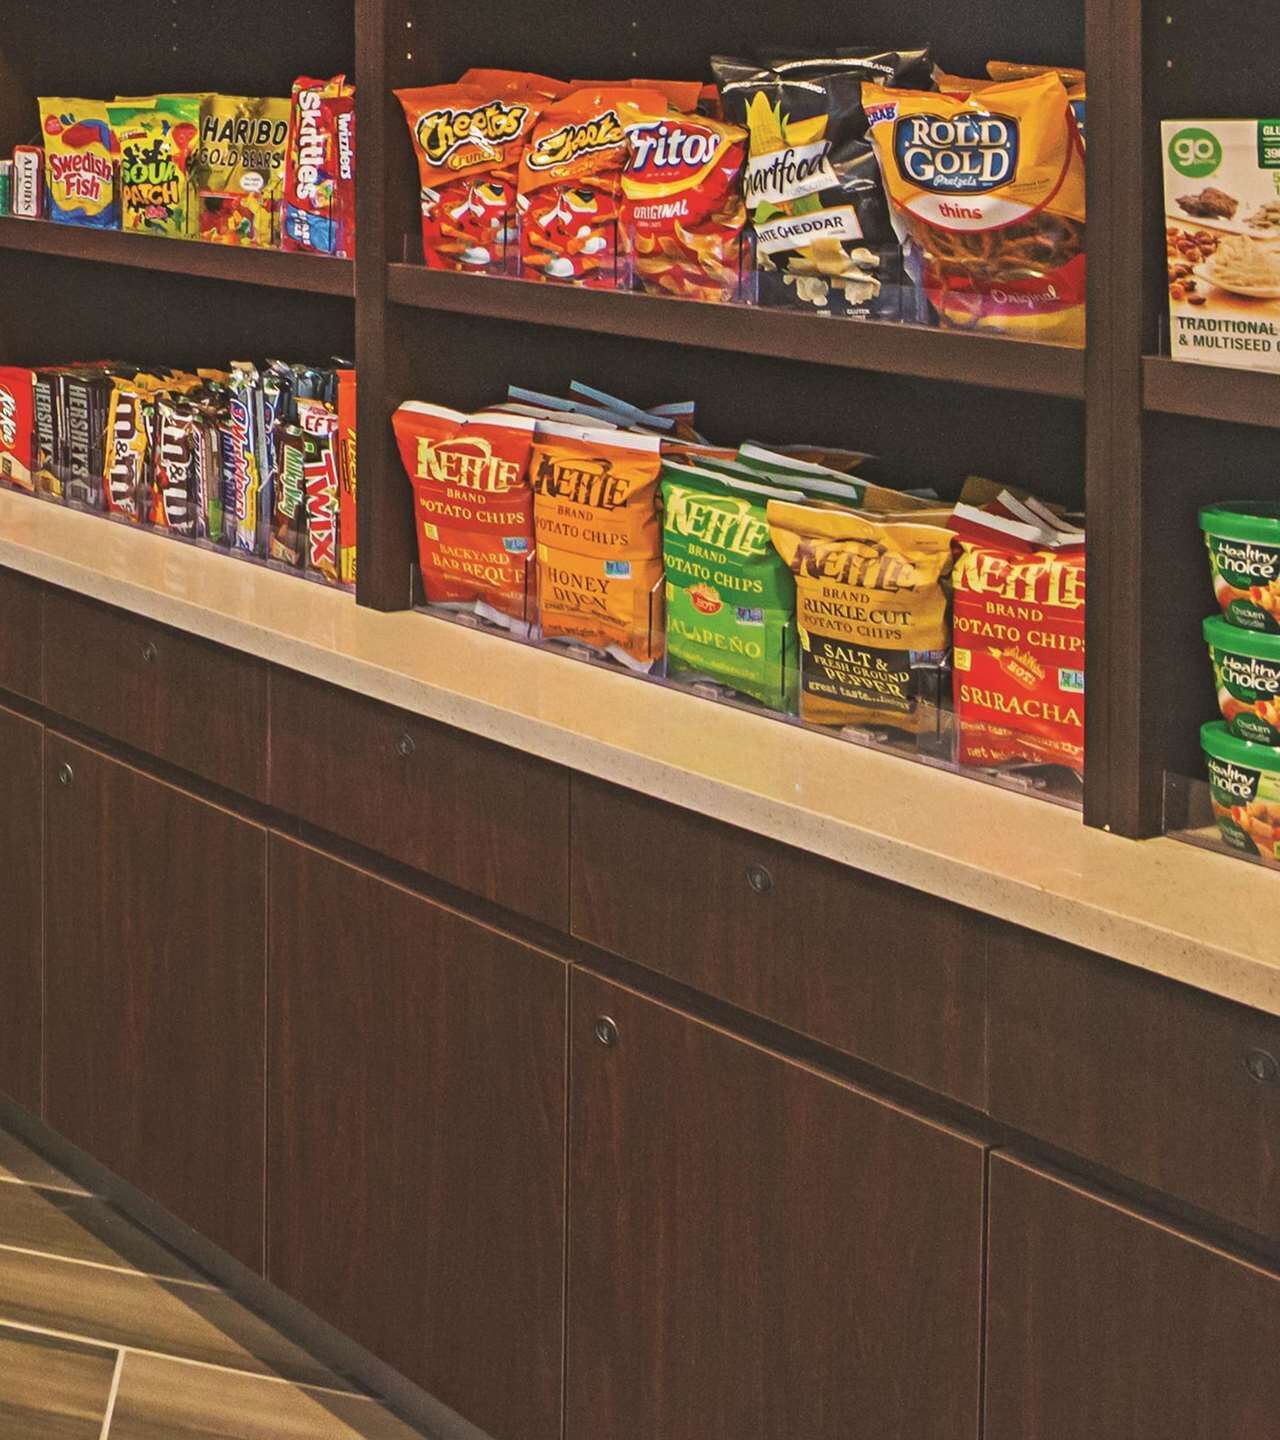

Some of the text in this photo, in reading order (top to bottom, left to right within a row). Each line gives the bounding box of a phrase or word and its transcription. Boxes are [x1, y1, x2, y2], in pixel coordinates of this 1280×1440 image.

[203, 116, 288, 145] HARIBO
[418, 103, 527, 165] Cheetos
[911, 119, 1006, 148] ROLD
[297, 90, 325, 199] Skittles
[1174, 138, 1215, 166] go
[49, 152, 112, 181] Swedish
[200, 148, 281, 169] GOLD BEARS
[903, 148, 1009, 182] GOLD
[24, 156, 33, 211] ALTOIDS
[122, 160, 179, 186] SOUR
[934, 174, 977, 188] Pretzels
[64, 174, 101, 201] Fish
[123, 179, 179, 206] PATCH
[633, 199, 689, 219] ORIGINAL
[938, 201, 983, 220] thins
[778, 216, 844, 241] CHEDDAR
[1177, 316, 1277, 336] TRADITIONAL
[1178, 334, 1271, 352] & MULTISEED
[69, 384, 89, 477] HERSHEY'S
[415, 436, 521, 494] KETTLE
[538, 454, 631, 510] KETTLE
[304, 449, 338, 566] TWIX
[446, 488, 487, 504] BRAND
[419, 498, 526, 525] POTATO CHIPS
[557, 505, 594, 522] BRAND
[664, 486, 771, 559] KETTLE
[582, 528, 630, 546] CHIPS
[688, 543, 727, 565] BRAND
[1216, 555, 1275, 578] Choice
[1218, 542, 1279, 567] Healthy
[548, 566, 610, 594] HONEY
[714, 570, 763, 593] CHIPS
[952, 541, 1085, 609] KETTLE
[822, 586, 871, 604] BRAND
[869, 610, 912, 626] CUT
[985, 601, 1044, 622] BRAND
[803, 616, 902, 640] POTATO CHIPS
[954, 617, 1020, 642] POTATO
[813, 654, 910, 684] FRESH GROUND
[823, 644, 888, 672] SALT &
[824, 667, 906, 700] PEPPER
[1221, 666, 1279, 693] Choice
[960, 686, 1082, 727] SRIRACHA
